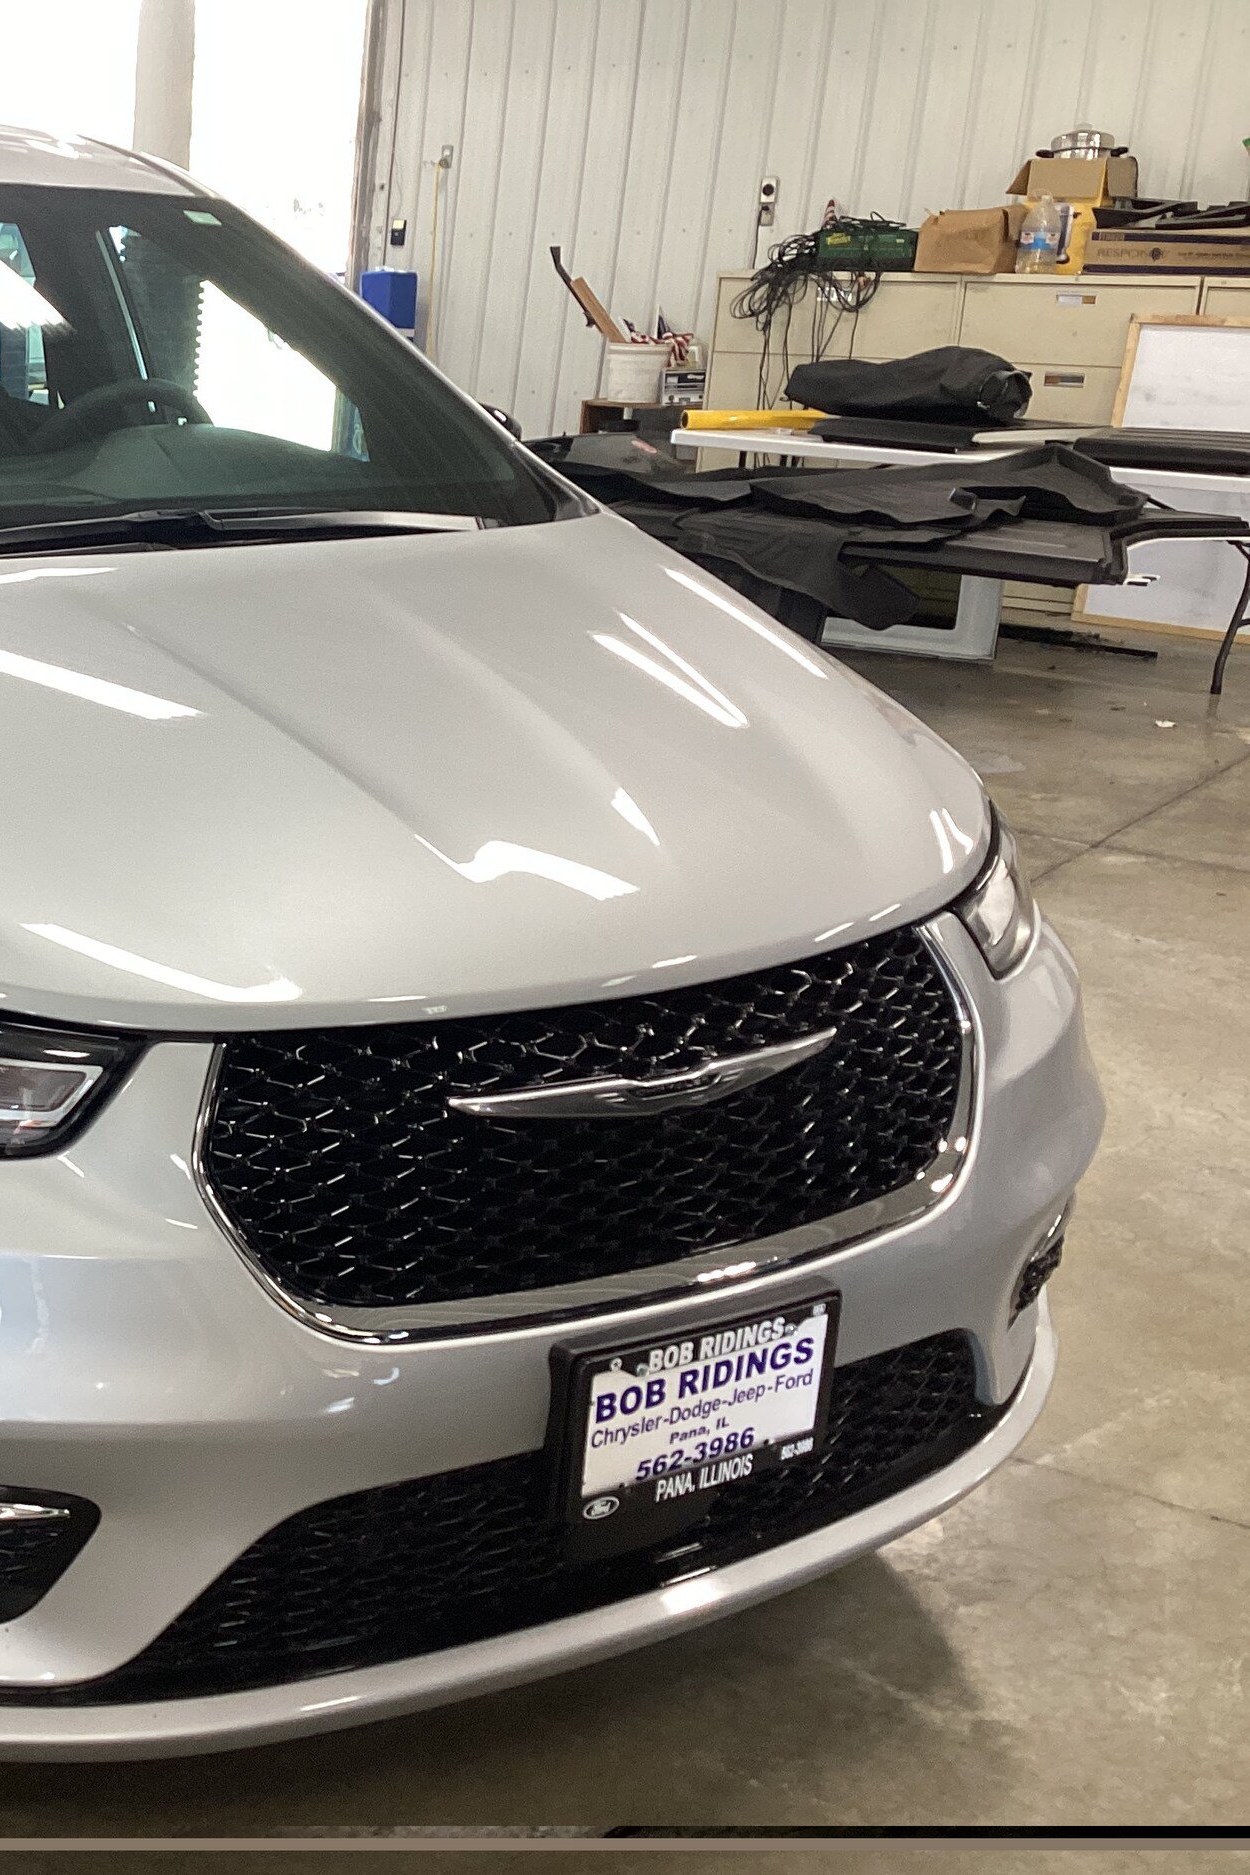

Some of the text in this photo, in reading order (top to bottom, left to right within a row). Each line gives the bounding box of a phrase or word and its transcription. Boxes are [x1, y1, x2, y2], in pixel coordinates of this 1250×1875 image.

[650, 1316, 785, 1372] BOB RIDINGS
[596, 1337, 814, 1424] BOB RIDINGS
[591, 1369, 813, 1449] Chrysler-Dodge-Jeep-Ford
[669, 1417, 729, 1445] Pana, IL
[636, 1427, 754, 1481] 562-3986
[699, 1453, 753, 1489] ILLINOIS
